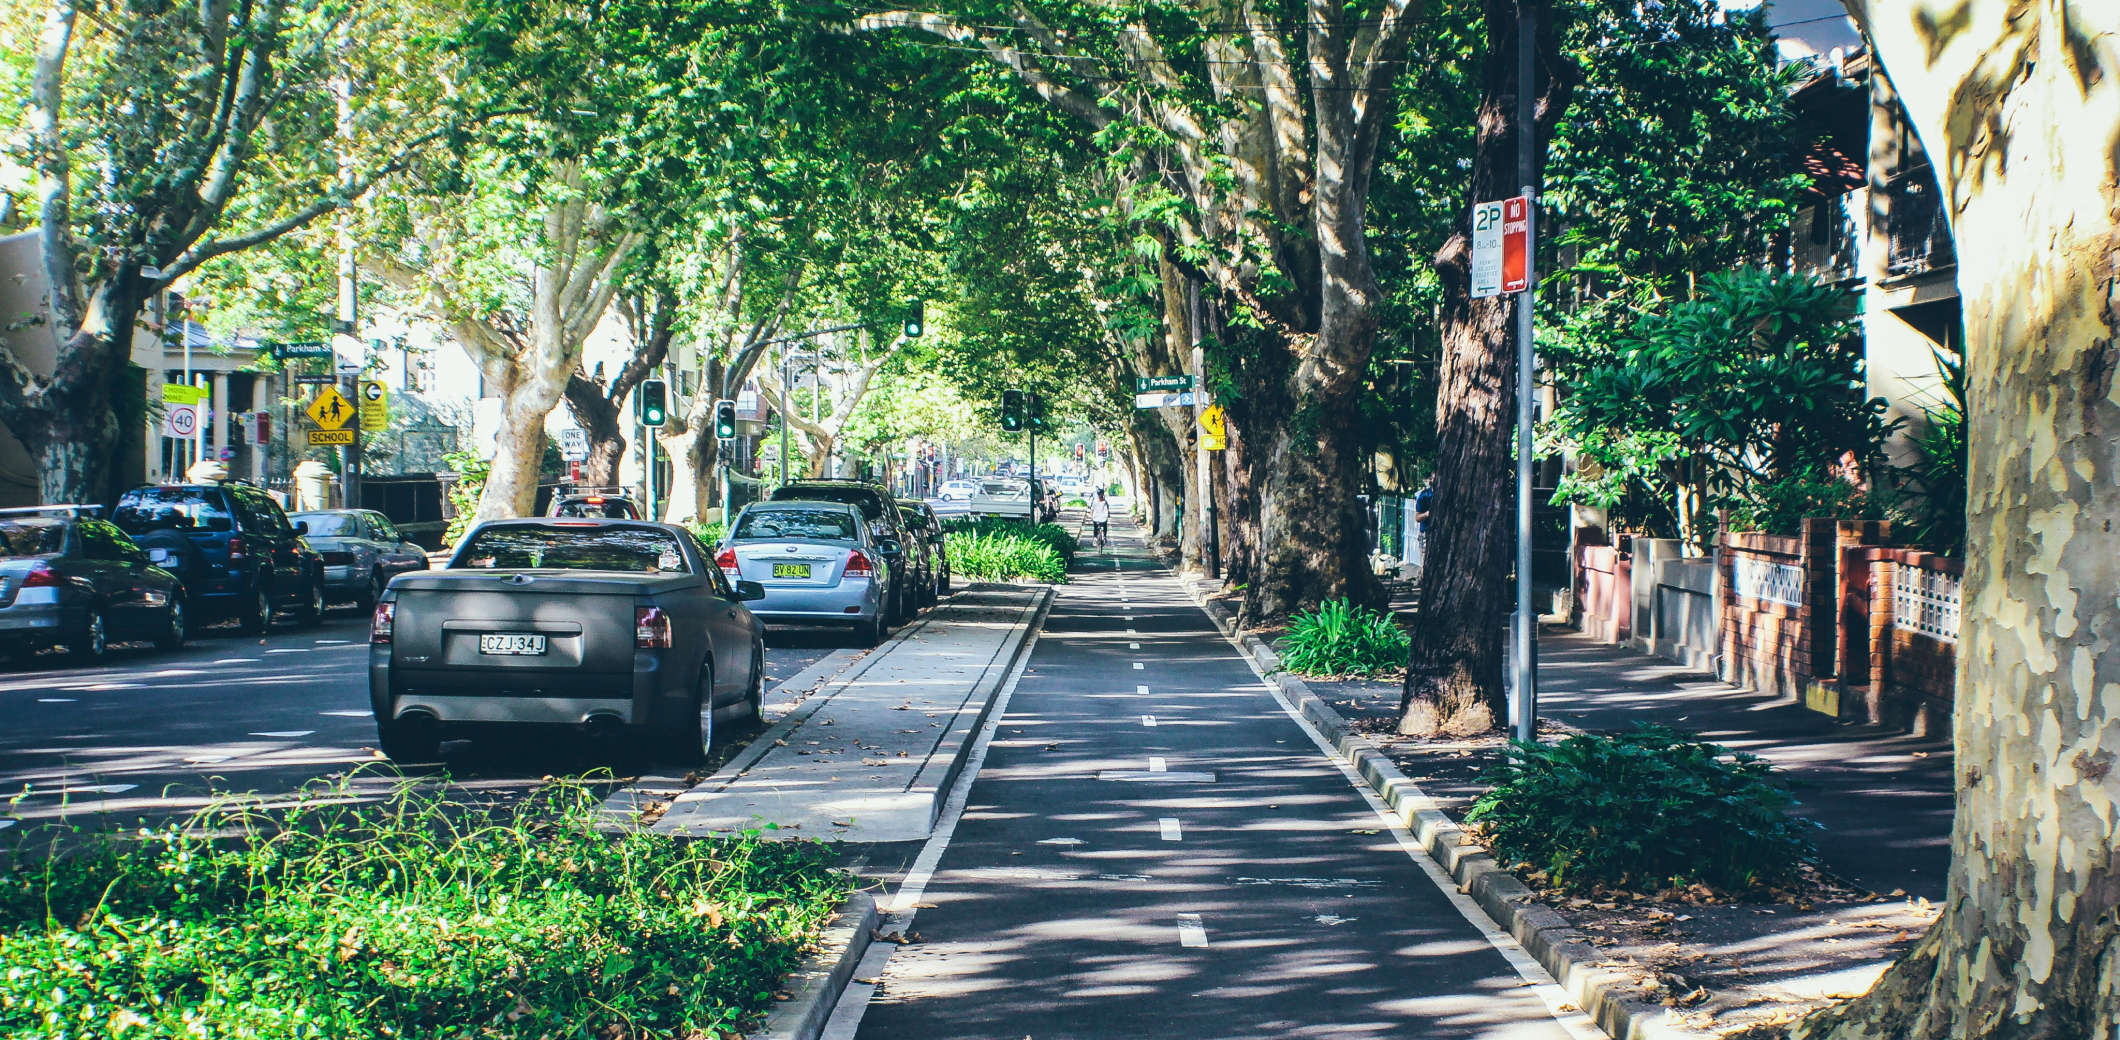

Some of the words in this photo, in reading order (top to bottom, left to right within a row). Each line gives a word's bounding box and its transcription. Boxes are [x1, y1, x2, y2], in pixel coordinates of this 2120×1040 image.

[1510, 203, 1520, 218] NO
[1476, 208, 1501, 231] 2P
[1504, 220, 1527, 235] STOPPING
[286, 344, 320, 353] Parkham
[1151, 378, 1178, 386] Parkham
[175, 415, 192, 427] 40
[312, 433, 350, 442] SCHOOL
[775, 565, 784, 574] BV
[787, 565, 796, 574] 82
[799, 565, 809, 574] UN
